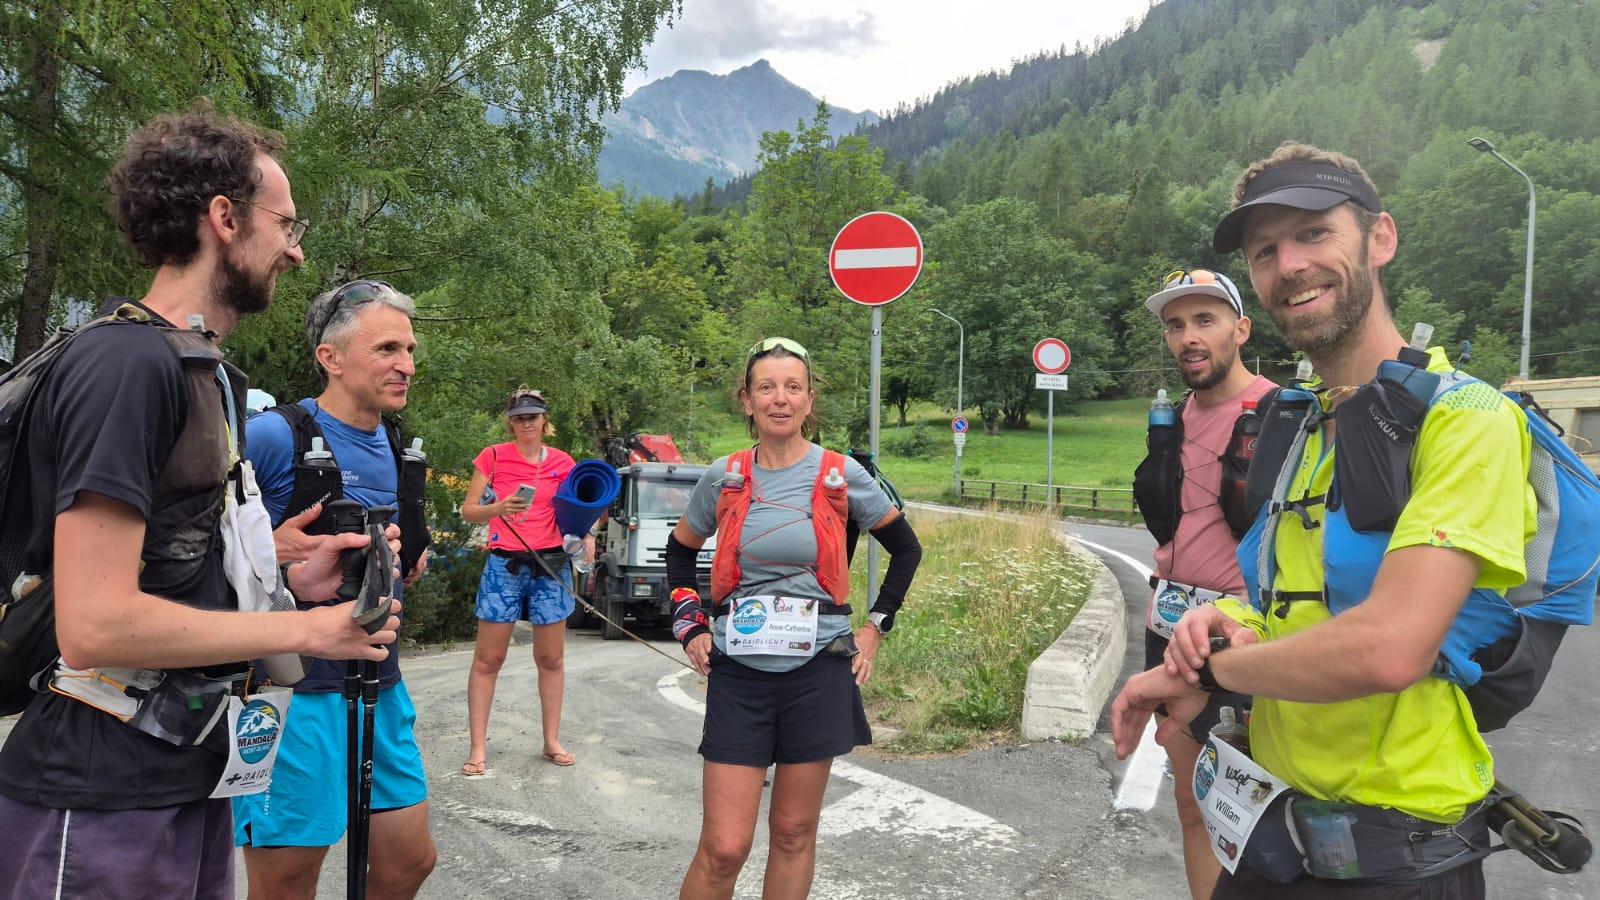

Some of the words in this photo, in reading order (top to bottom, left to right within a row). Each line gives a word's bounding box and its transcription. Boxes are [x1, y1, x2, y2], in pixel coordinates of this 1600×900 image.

[1316, 172, 1352, 187] KIPRUN
[742, 638, 785, 647] RAIDLIGHT
[238, 731, 277, 748] MANDALA
[1215, 797, 1241, 826] William
